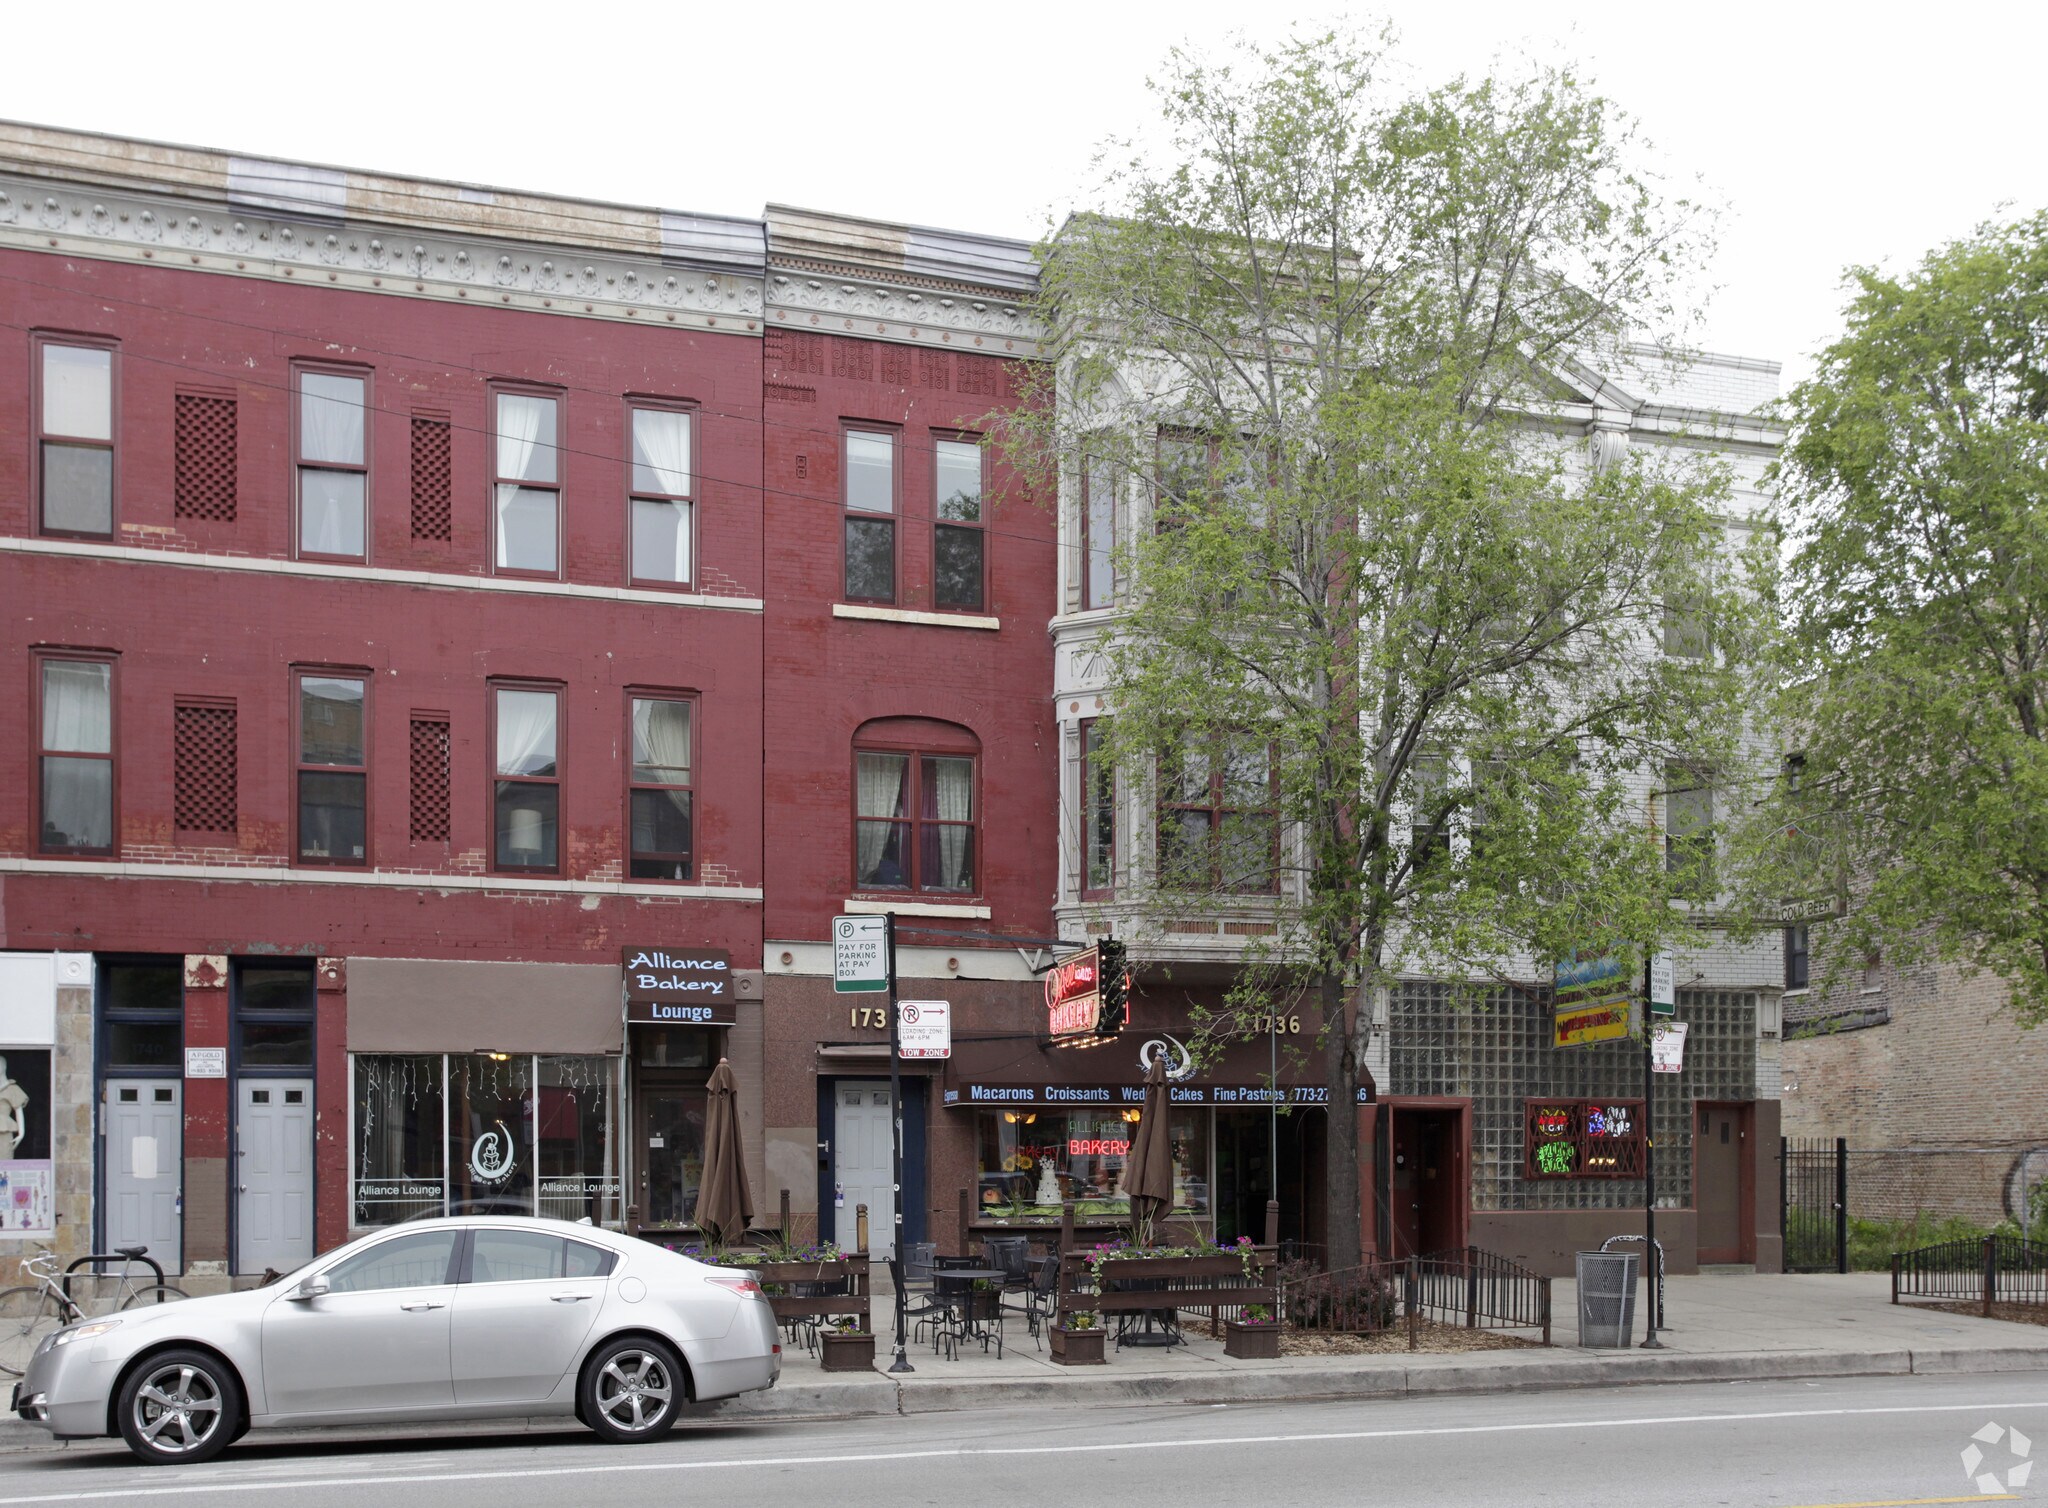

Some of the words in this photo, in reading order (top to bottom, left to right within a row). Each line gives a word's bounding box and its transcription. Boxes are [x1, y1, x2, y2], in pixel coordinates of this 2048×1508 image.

[1782, 905, 1803, 920] COLD
[1808, 900, 1829, 915] BEER
[628, 952, 728, 970] Alliance
[853, 960, 870, 968] PAY
[839, 969, 856, 977] BOX
[636, 974, 723, 994] Bakery
[652, 1003, 712, 1022] Lounge
[851, 1008, 886, 1029] 173
[1252, 1015, 1300, 1034] 1736
[971, 1086, 1034, 1100] Macarons
[1045, 1087, 1110, 1100] Croissants
[1170, 1087, 1204, 1101] Cakes
[1213, 1088, 1236, 1101] Fine
[1069, 1121, 1128, 1133] ALLIANCE
[1070, 1140, 1130, 1155] BAKERY
[494, 1161, 518, 1185] Bakery
[358, 1185, 399, 1195] Alliance
[402, 1185, 441, 1196] Lounge
[541, 1182, 580, 1192] Alliance
[583, 1182, 620, 1194] Lounge
